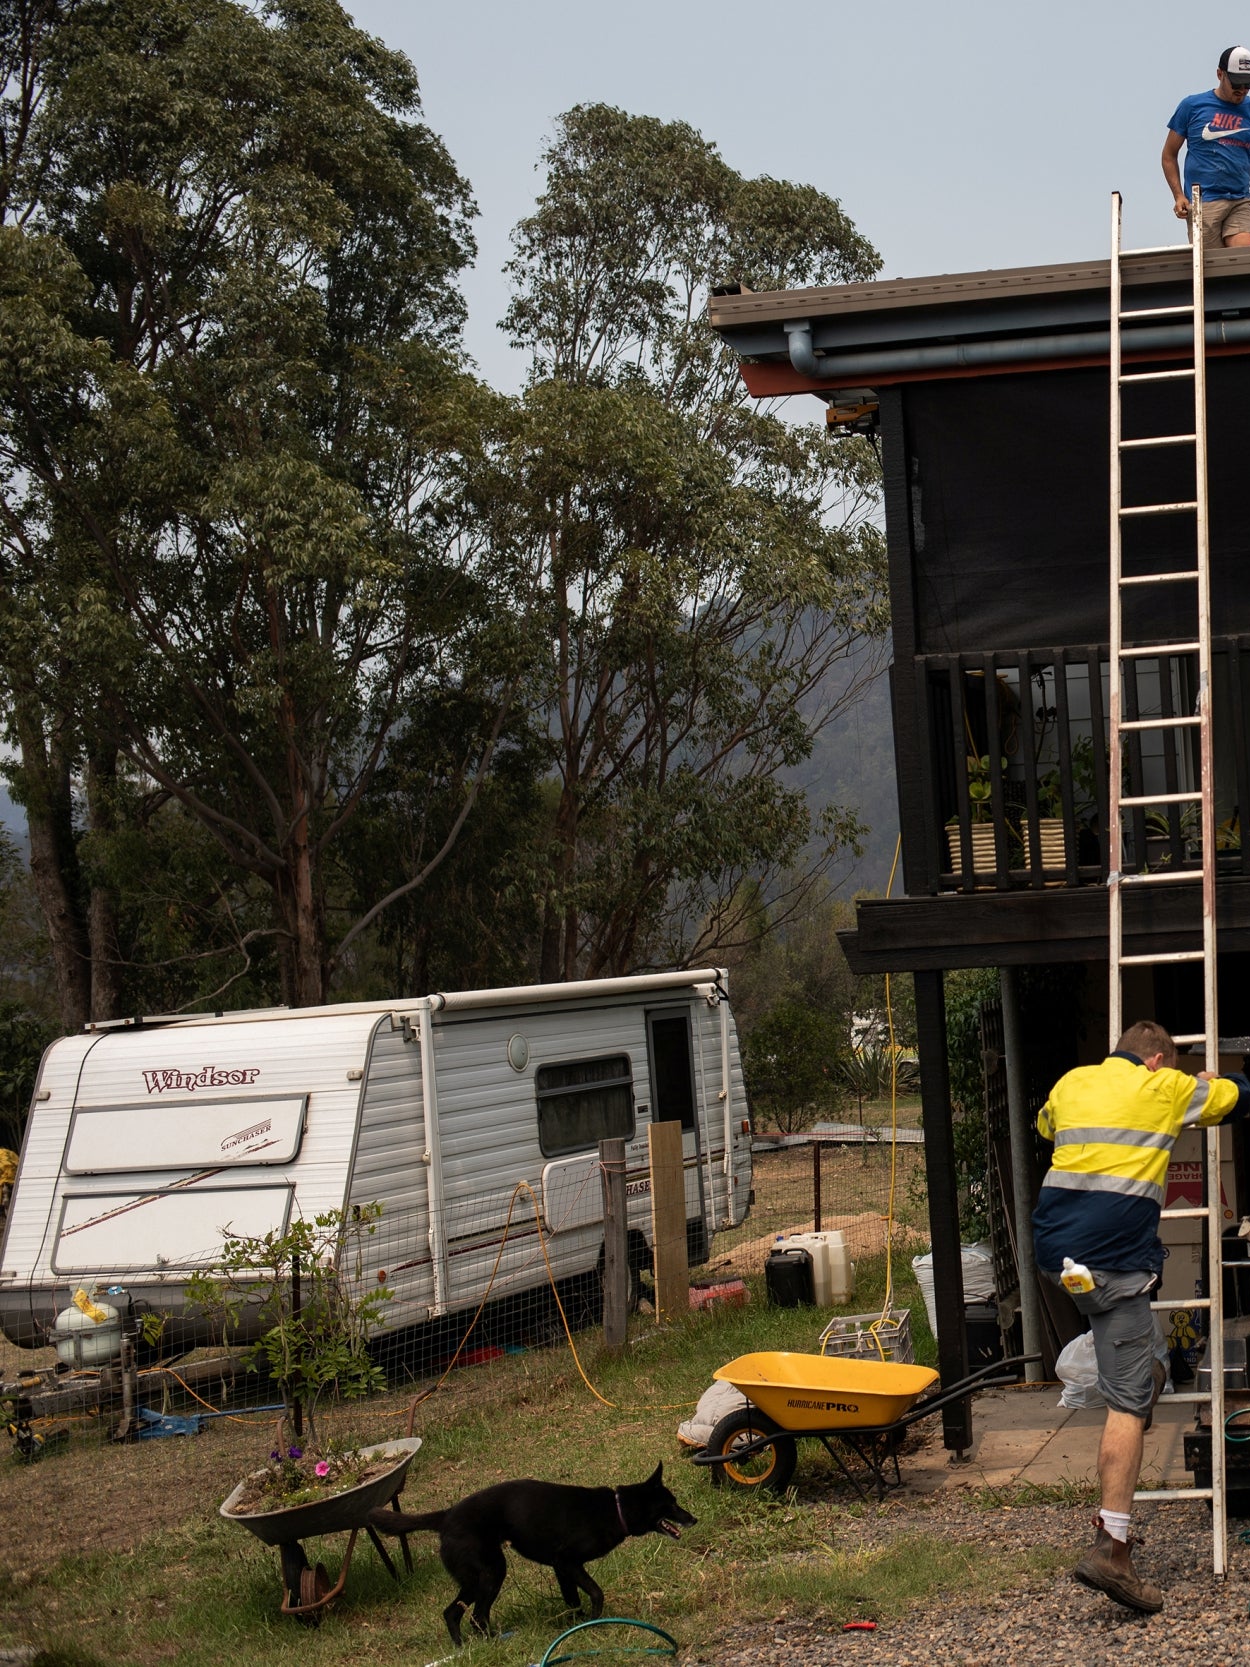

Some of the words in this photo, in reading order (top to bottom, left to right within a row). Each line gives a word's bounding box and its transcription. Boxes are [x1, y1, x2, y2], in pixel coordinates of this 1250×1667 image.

[1210, 112, 1243, 130] NIKE
[142, 1066, 260, 1094] Windsor
[220, 1124, 272, 1152] SUNCHASER
